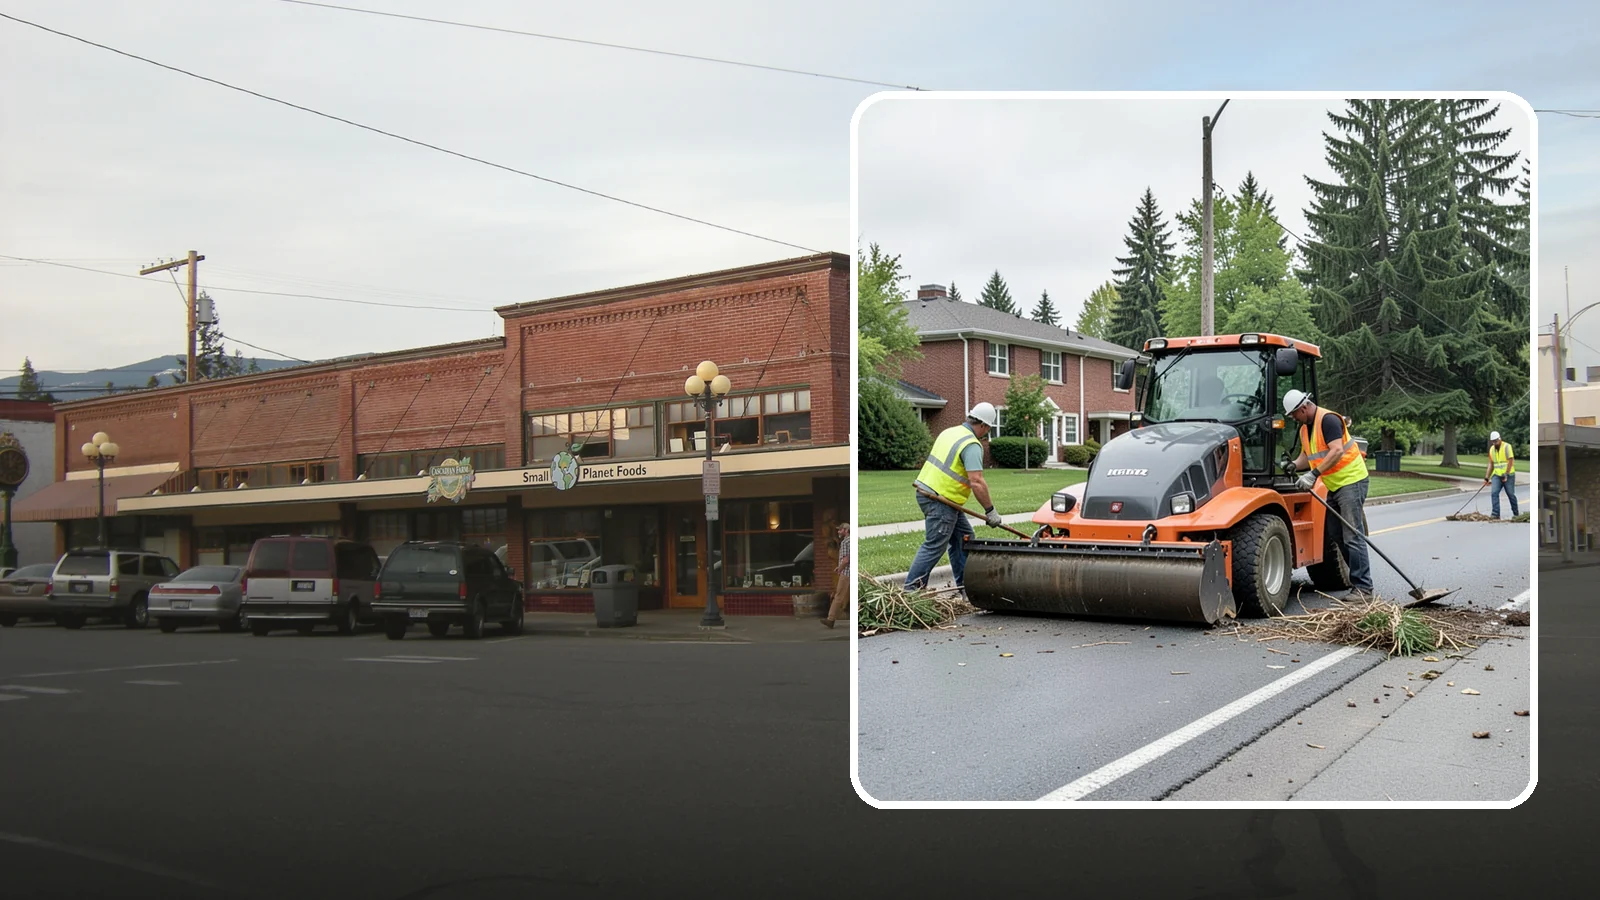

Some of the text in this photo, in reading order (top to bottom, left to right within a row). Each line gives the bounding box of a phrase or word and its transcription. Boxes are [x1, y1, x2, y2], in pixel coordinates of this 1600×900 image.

[523, 464, 647, 483] Small Planet Foods
